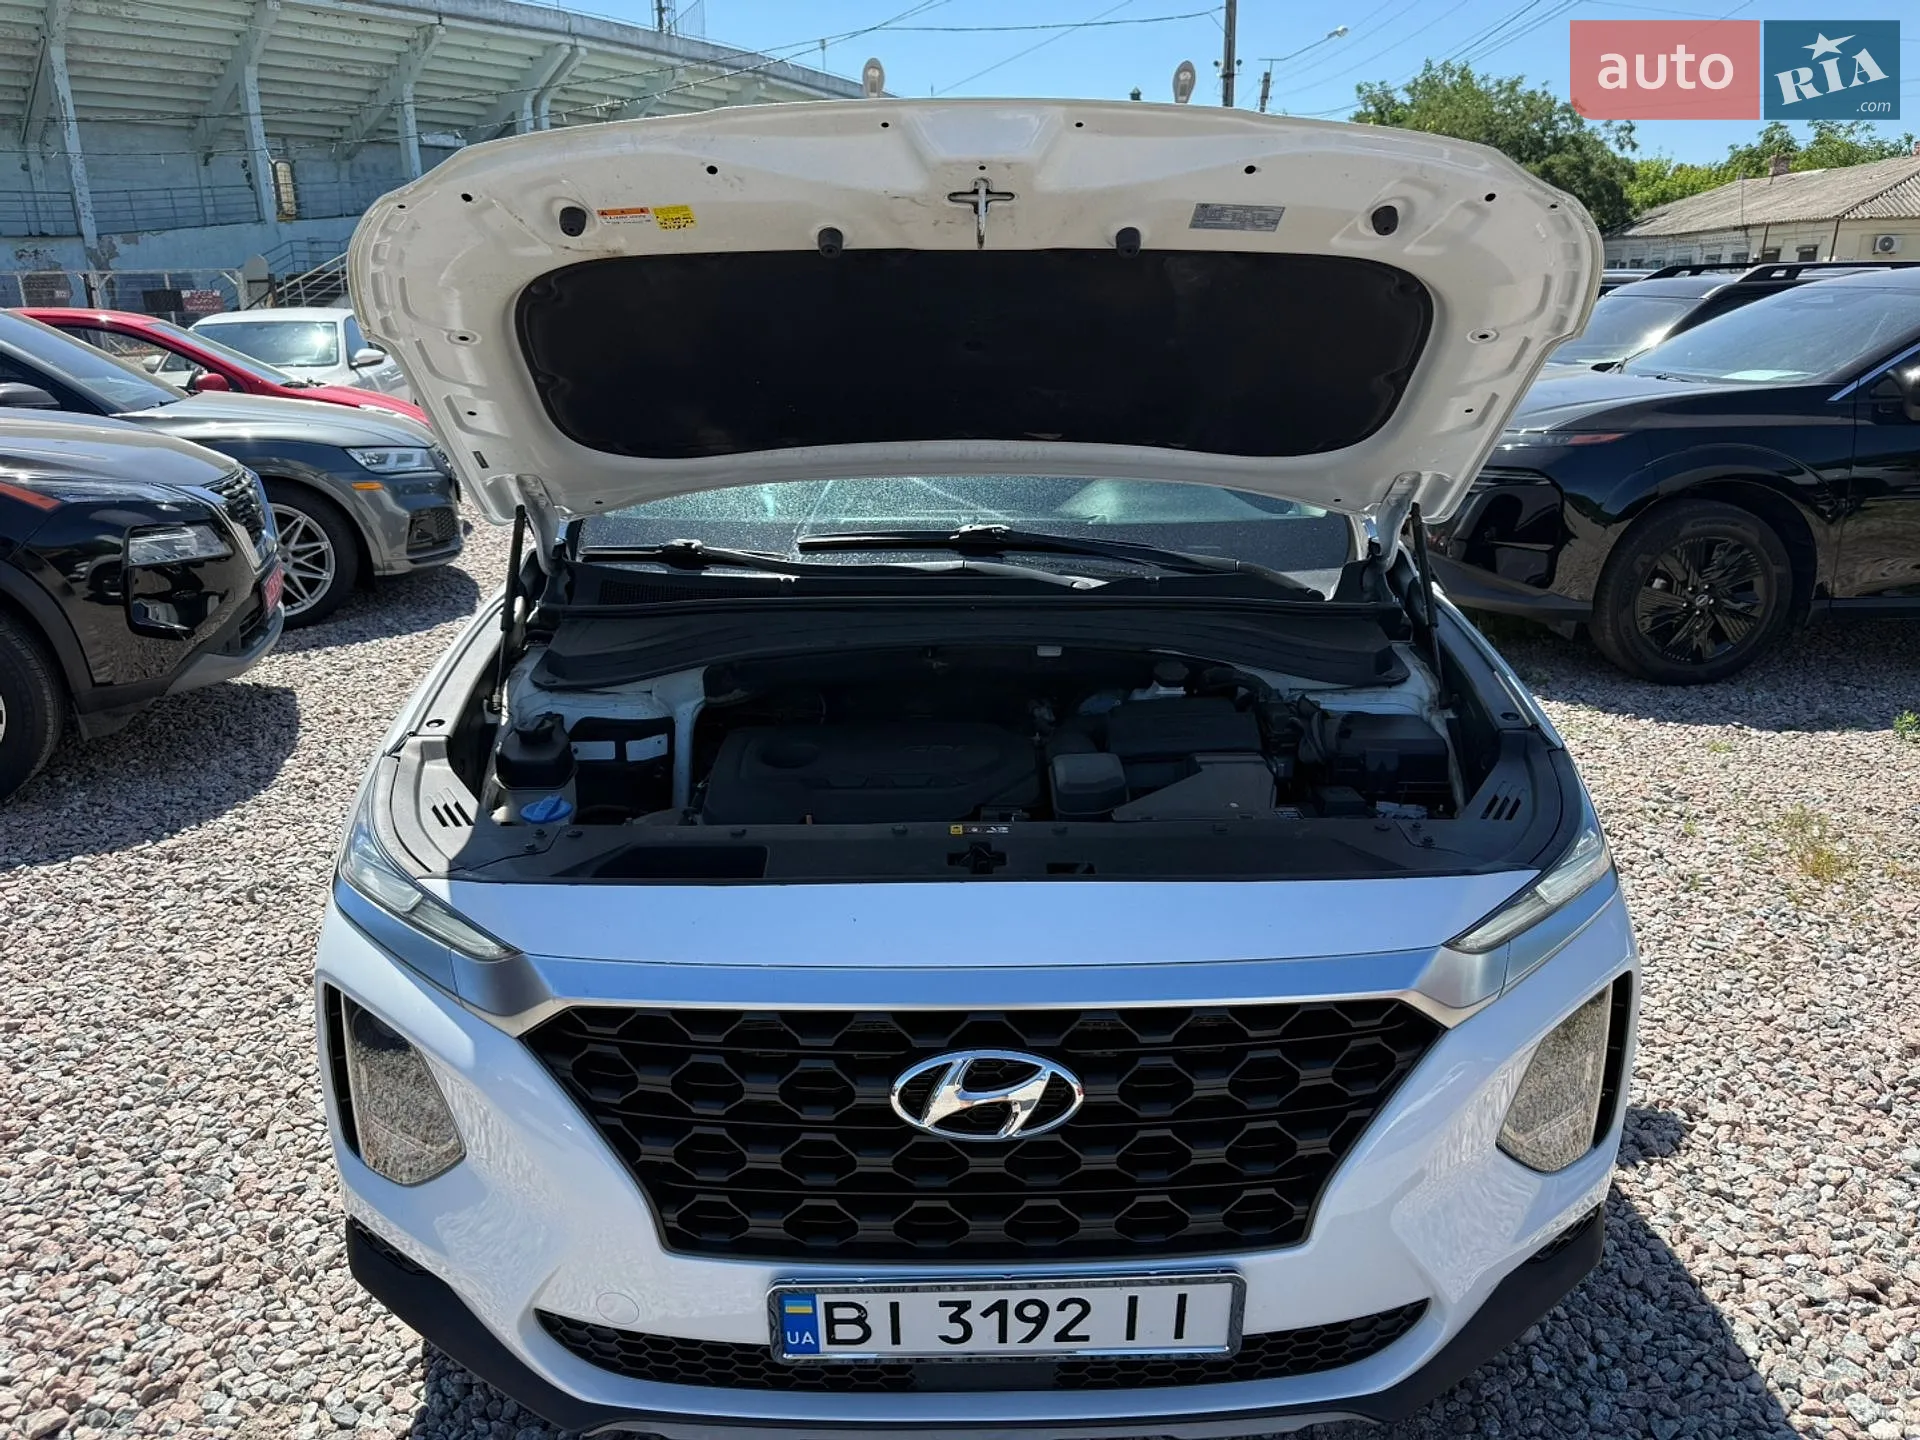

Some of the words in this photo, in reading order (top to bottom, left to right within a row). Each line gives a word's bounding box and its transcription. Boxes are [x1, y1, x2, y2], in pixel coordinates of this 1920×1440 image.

[823, 1301, 901, 1346] BI
[938, 1297, 1092, 1345] 3192
[787, 1331, 815, 1346] UA
